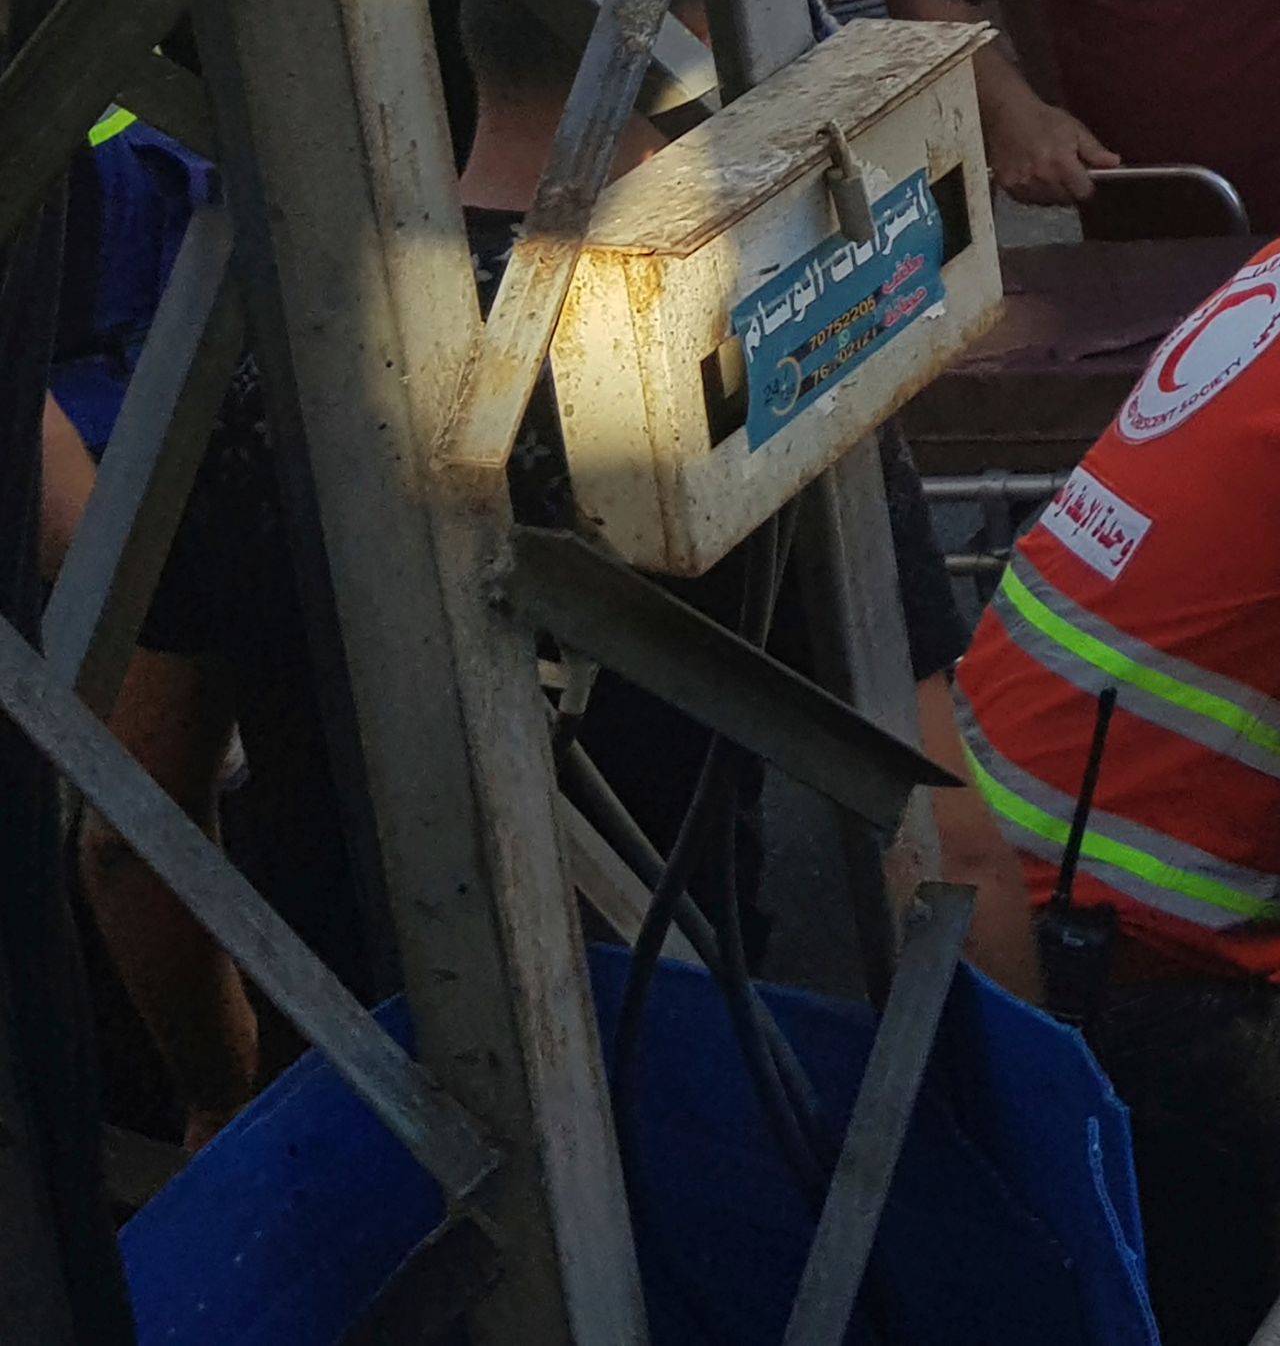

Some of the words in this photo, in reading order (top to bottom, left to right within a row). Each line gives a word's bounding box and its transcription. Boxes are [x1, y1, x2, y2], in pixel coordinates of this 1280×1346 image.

[745, 257, 824, 362] الوسام
[808, 295, 877, 351] 70752205
[811, 326, 877, 387] 7602121
[1179, 357, 1242, 413] SOCIETY
